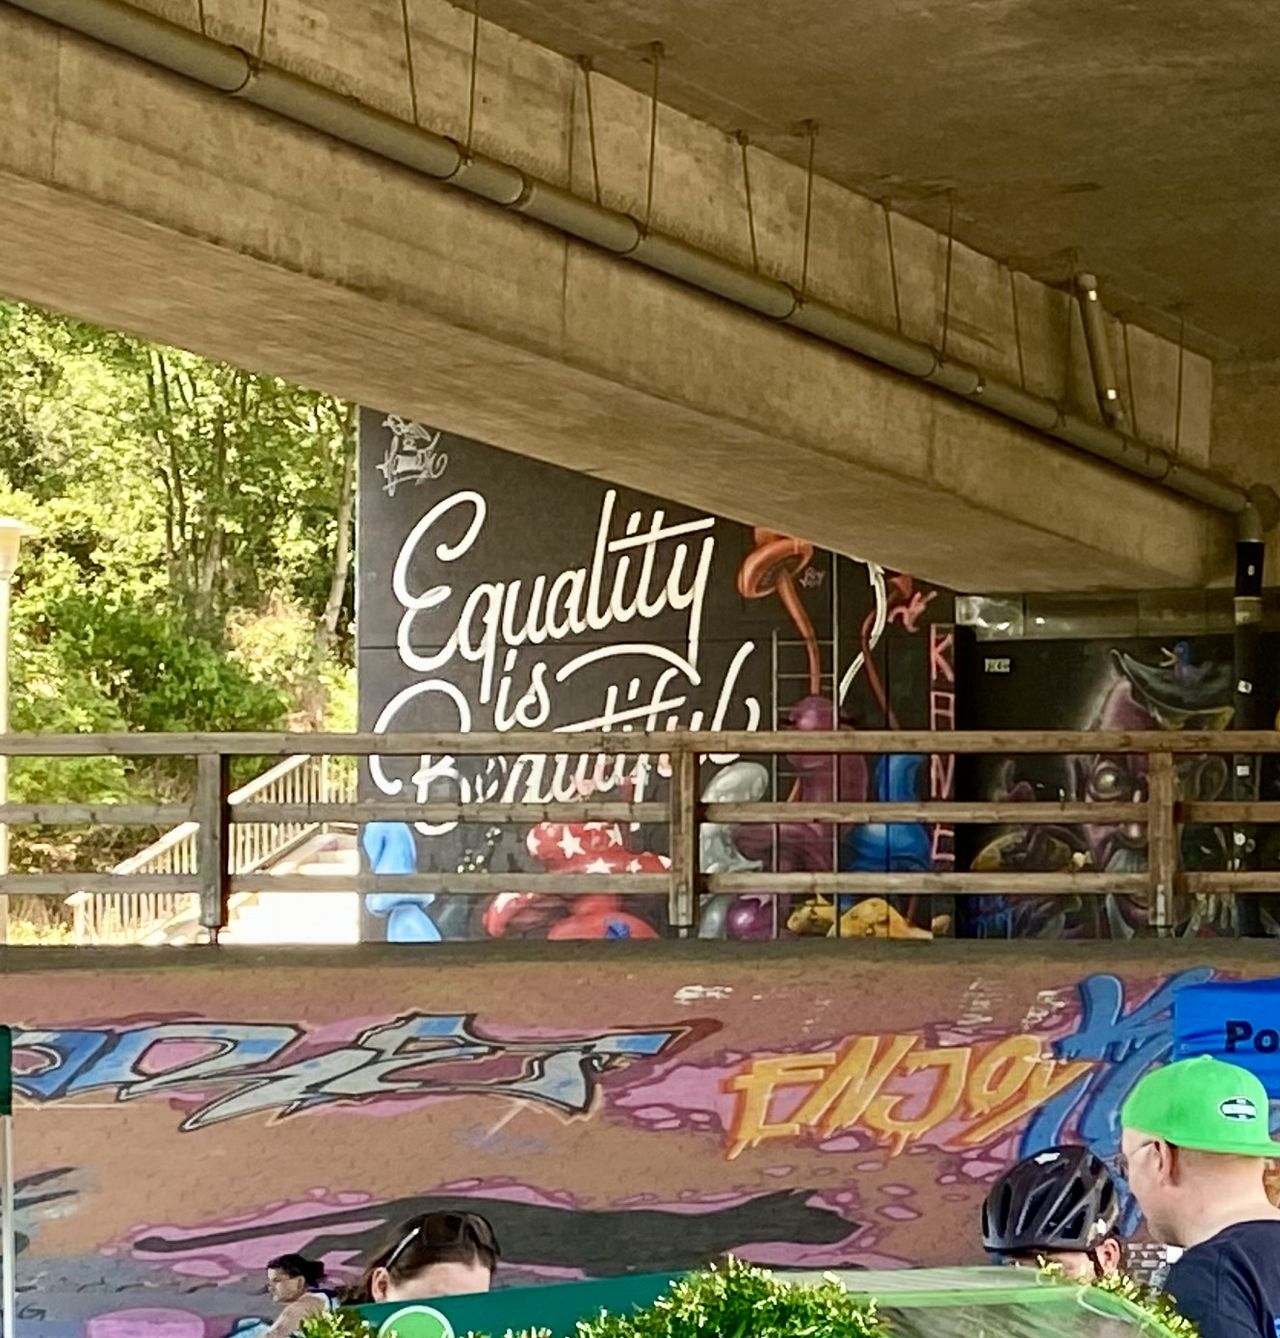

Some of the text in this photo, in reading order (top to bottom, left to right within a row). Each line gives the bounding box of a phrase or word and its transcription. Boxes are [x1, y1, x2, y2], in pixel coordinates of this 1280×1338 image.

[392, 489, 716, 703] Equality
[494, 648, 551, 732] is
[722, 1033, 1096, 1160] ENJOY
